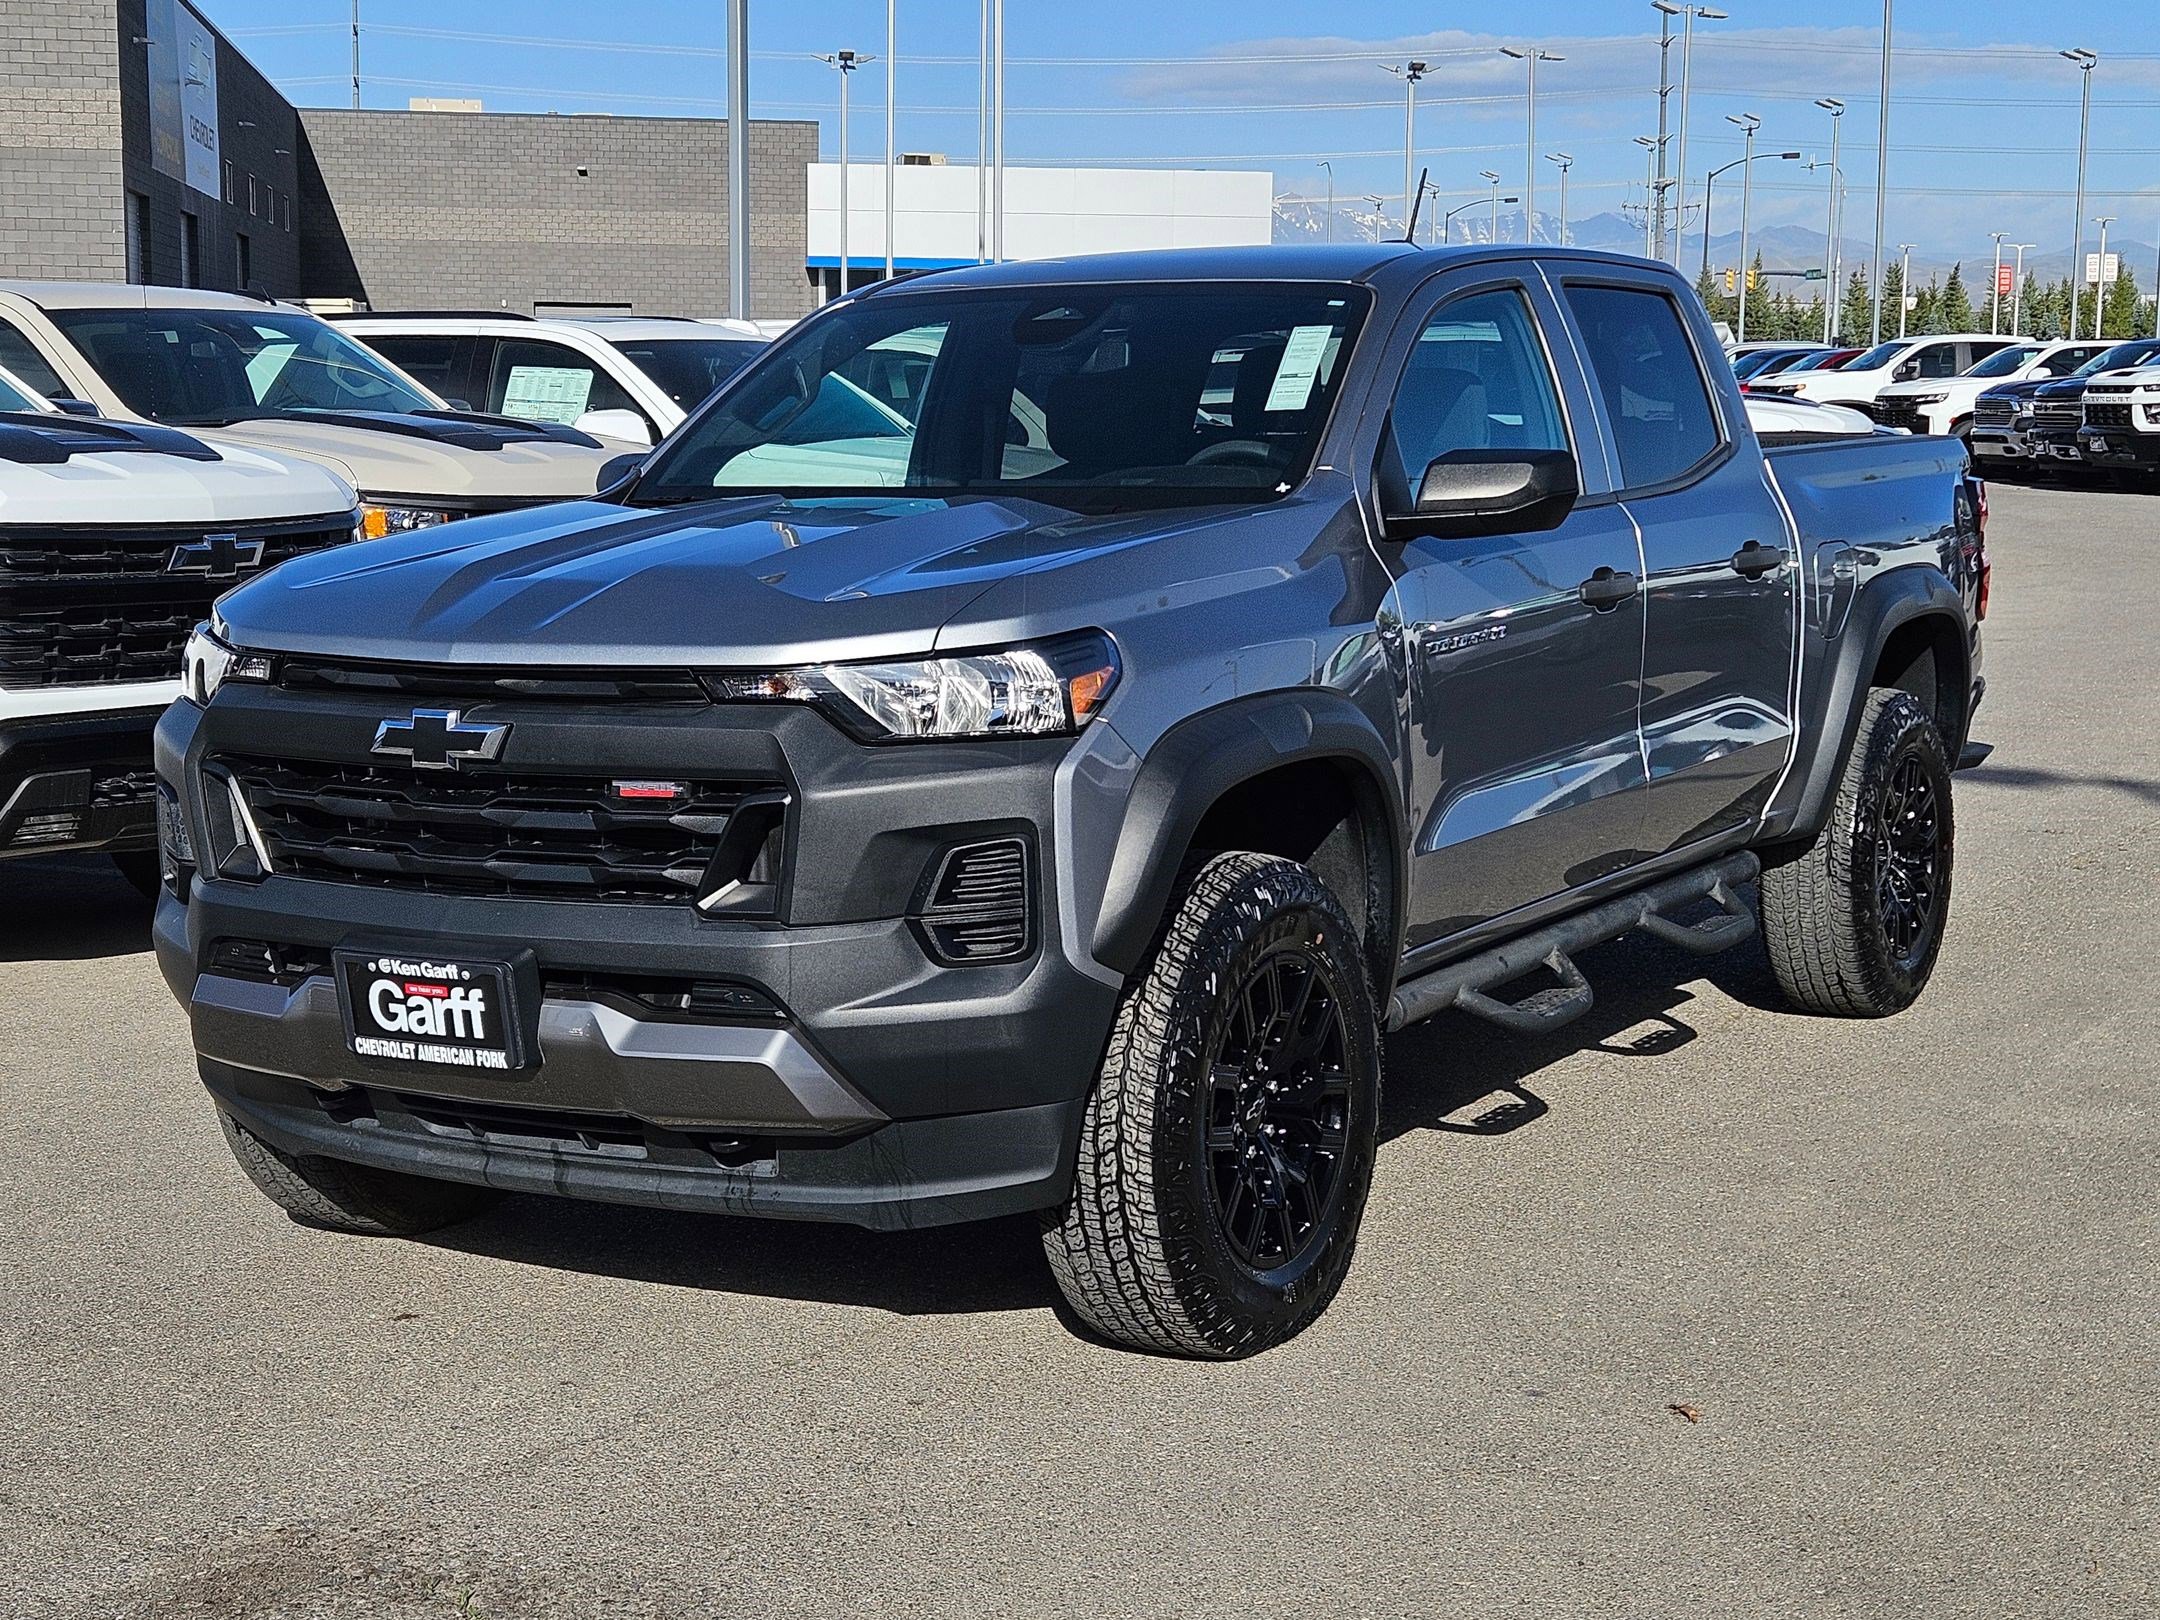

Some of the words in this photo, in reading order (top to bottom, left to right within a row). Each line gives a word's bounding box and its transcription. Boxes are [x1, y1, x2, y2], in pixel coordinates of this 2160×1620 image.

[368, 979, 485, 1039] Garff
[355, 1036, 416, 1060] CHEVROLET
[418, 1043, 475, 1066] AMERICAN
[476, 1050, 508, 1069] FORK
